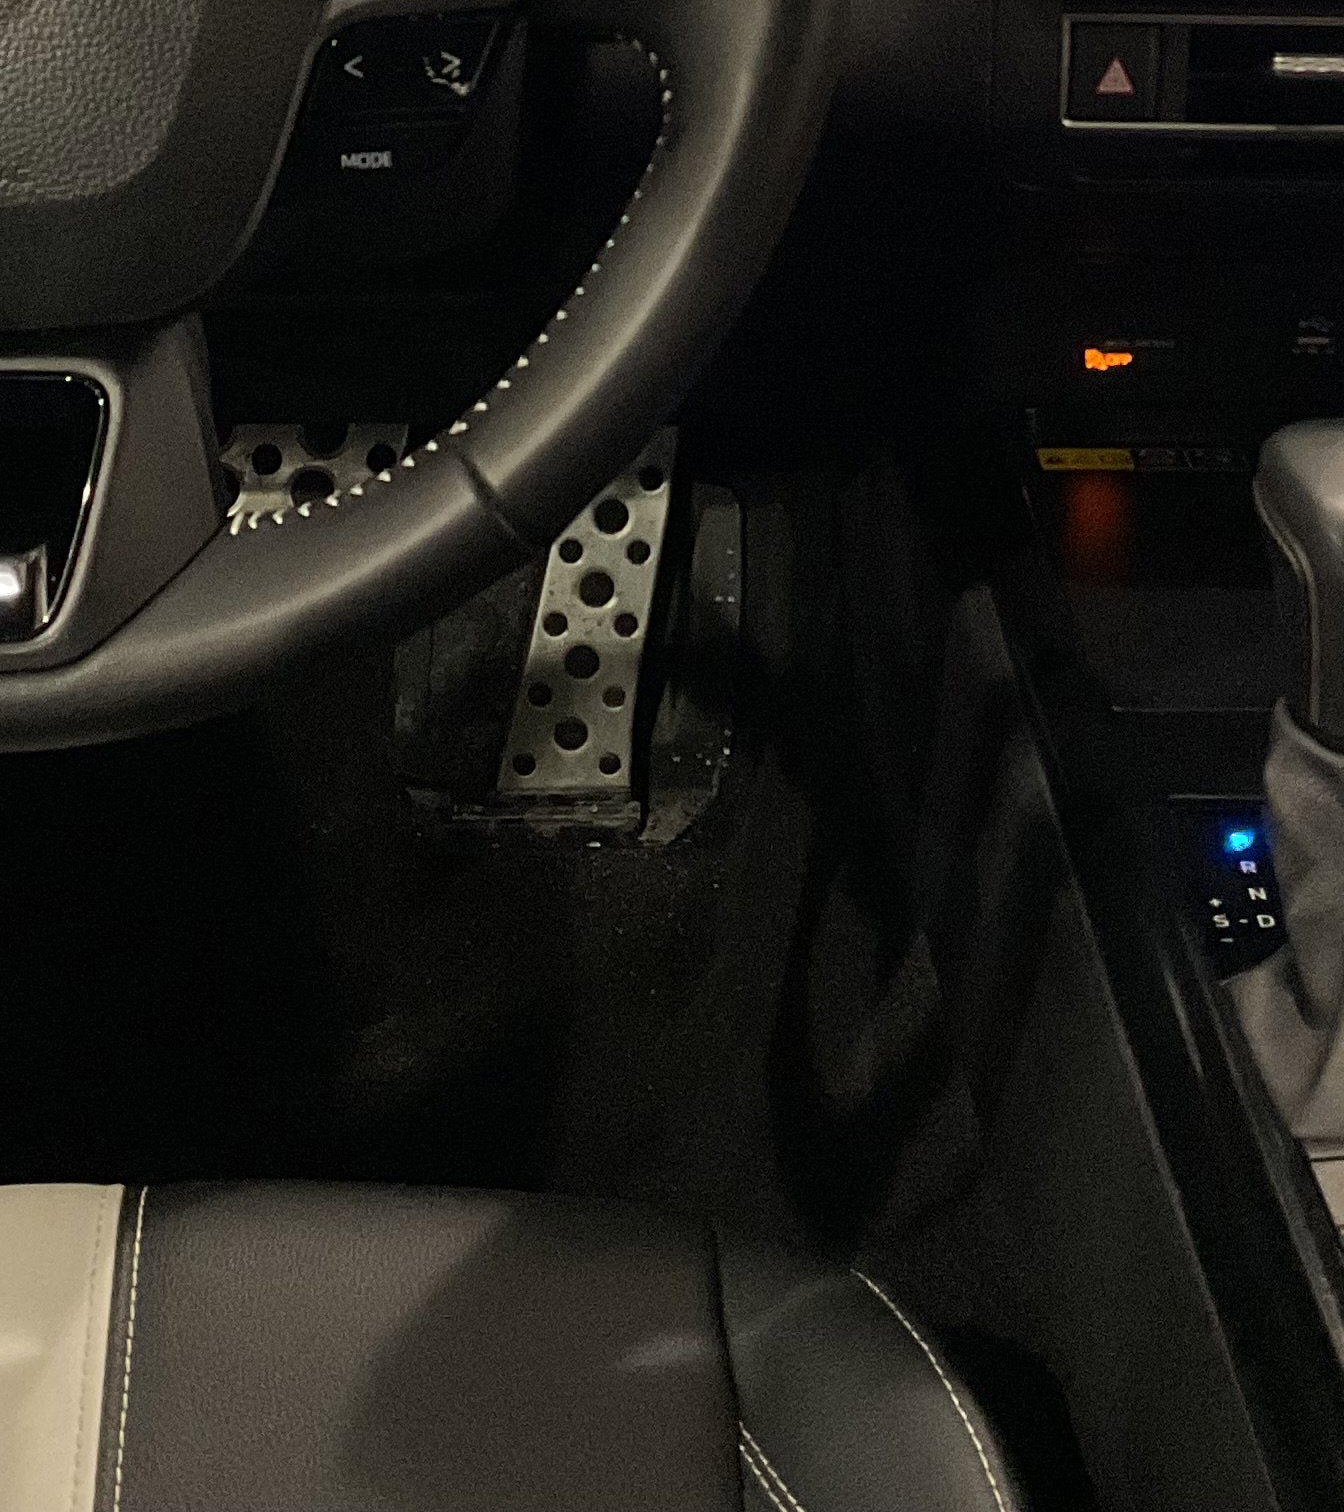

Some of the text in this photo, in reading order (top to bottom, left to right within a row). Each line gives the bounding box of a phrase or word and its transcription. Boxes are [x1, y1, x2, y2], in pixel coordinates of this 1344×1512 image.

[340, 151, 392, 169] MODE
[1248, 888, 1268, 901] N
[1212, 914, 1230, 928] S
[1256, 914, 1276, 928] D
